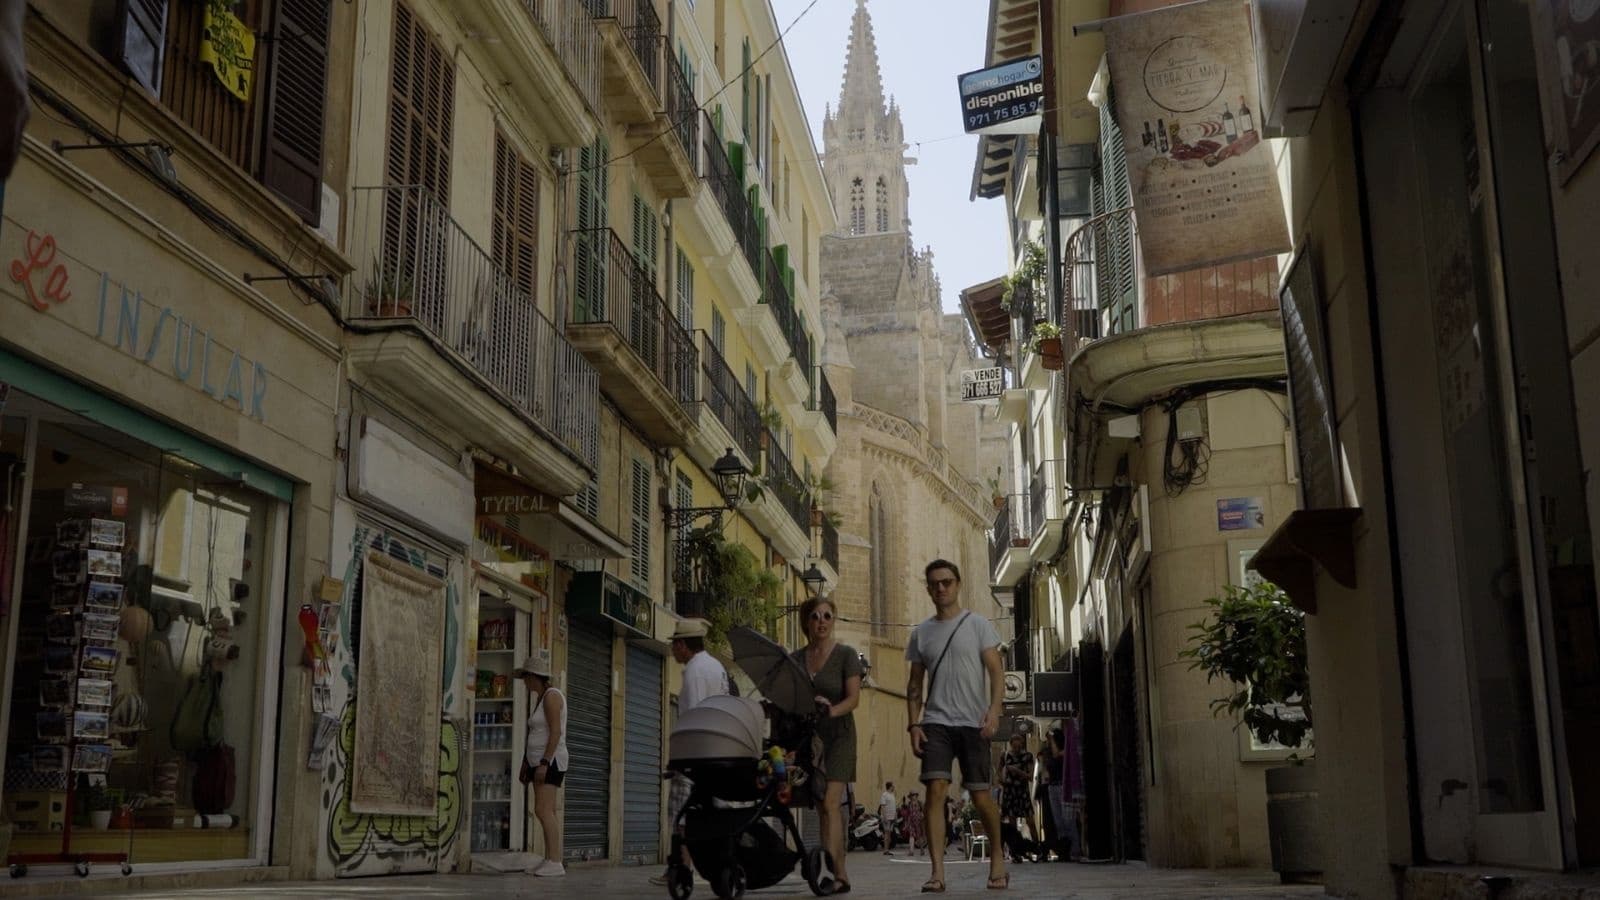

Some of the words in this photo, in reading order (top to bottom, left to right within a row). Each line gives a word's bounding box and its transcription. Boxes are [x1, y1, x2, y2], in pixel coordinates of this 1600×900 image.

[966, 82, 1043, 110] disponible
[969, 112, 990, 126] 971
[993, 106, 1009, 121] 75
[1011, 103, 1027, 117] 85
[10, 229, 71, 312] La
[96, 271, 268, 423] INSULAR
[974, 368, 1000, 381] VENDE
[481, 495, 550, 513] TYPICAL
